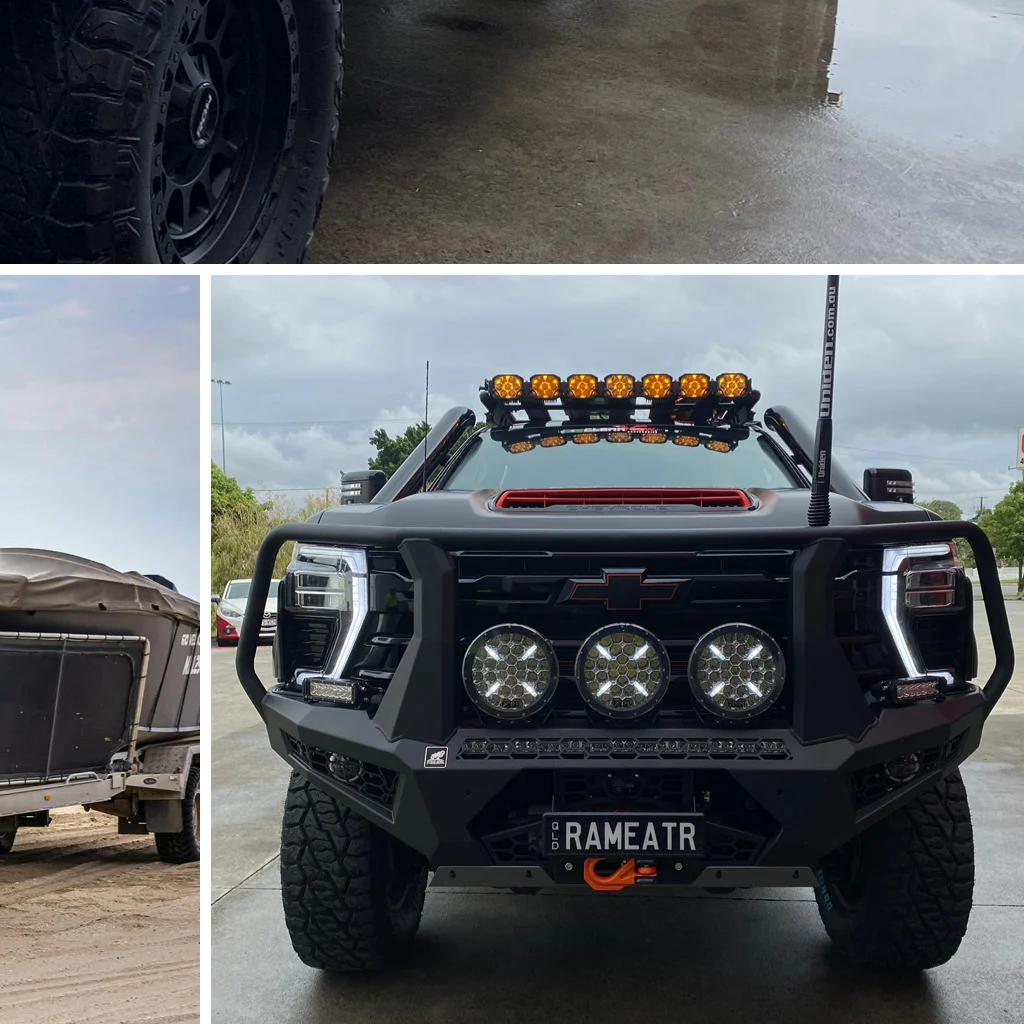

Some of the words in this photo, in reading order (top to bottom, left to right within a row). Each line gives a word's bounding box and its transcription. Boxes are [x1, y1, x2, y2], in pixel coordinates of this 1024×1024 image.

[820, 286, 837, 417] Uniden.com.au
[817, 450, 826, 478] Uniden
[551, 821, 559, 850] QLD
[565, 821, 696, 850] RAMEATR
